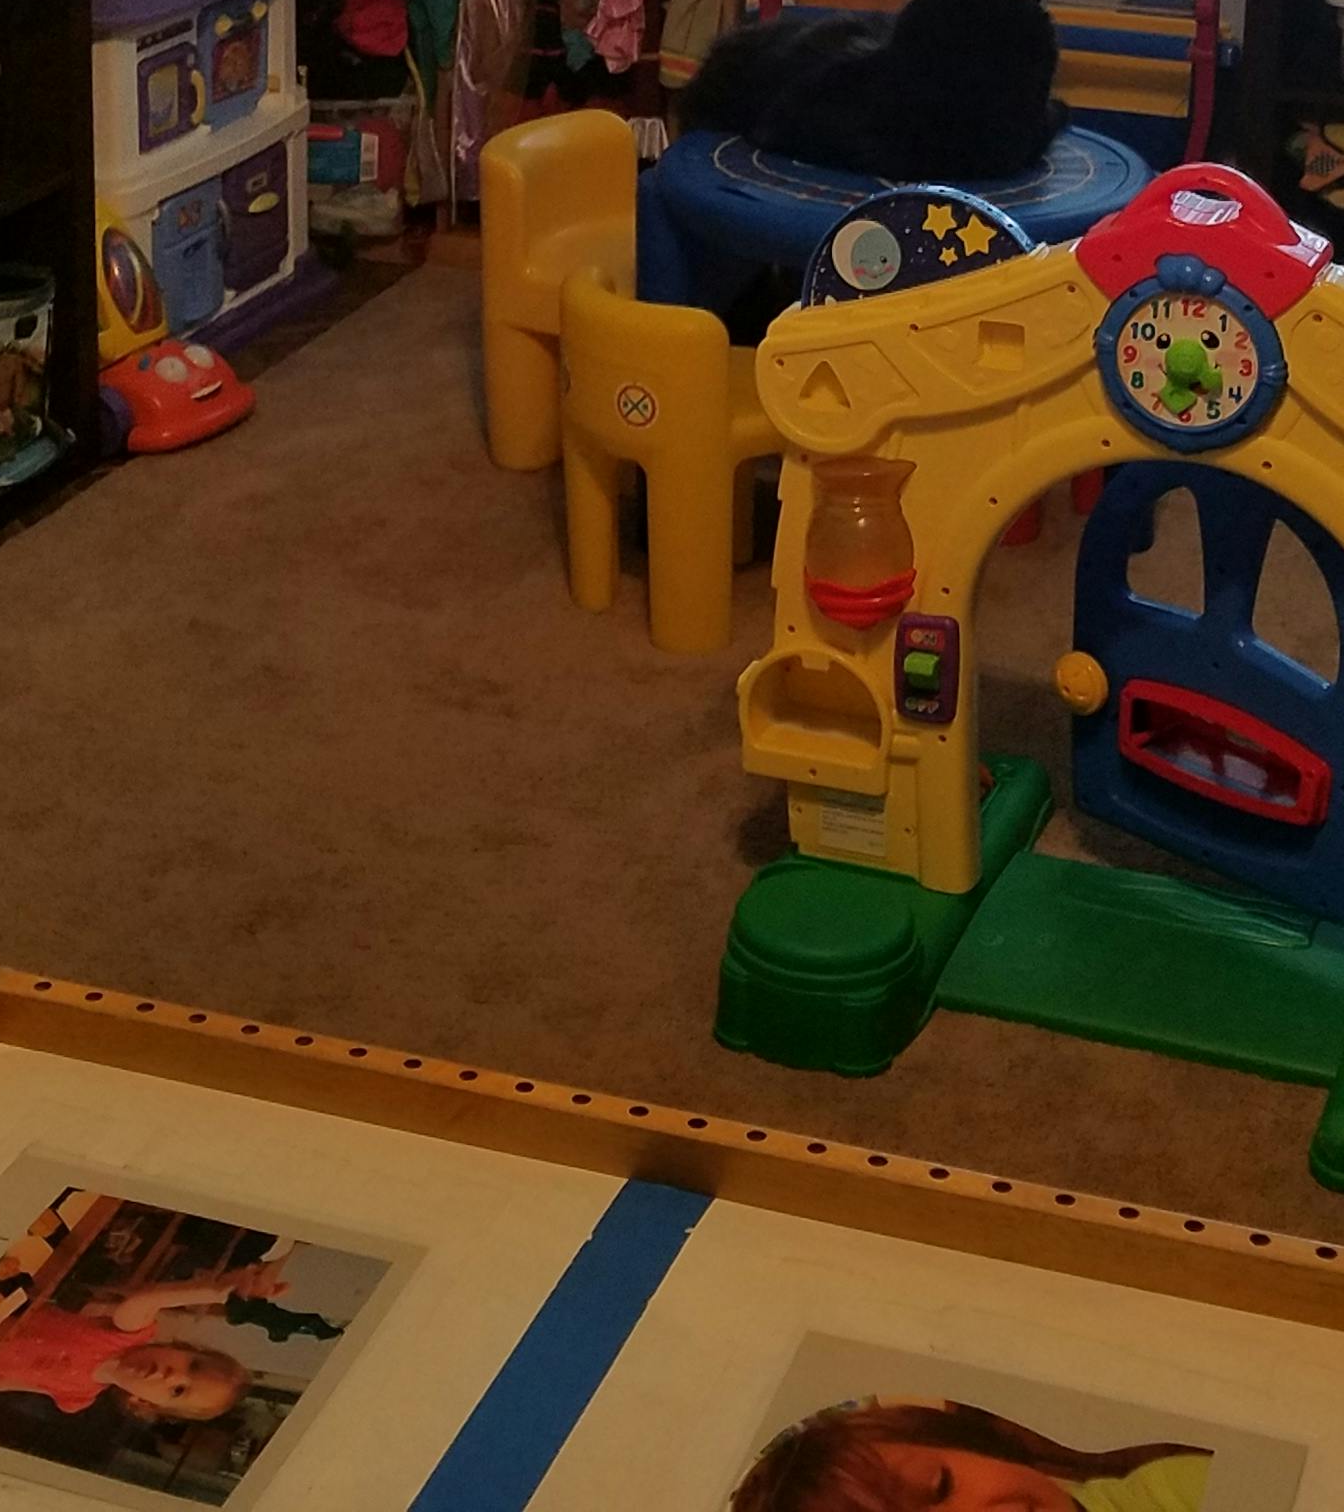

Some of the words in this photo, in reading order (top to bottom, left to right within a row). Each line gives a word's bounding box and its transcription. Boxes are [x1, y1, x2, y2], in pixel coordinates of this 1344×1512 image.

[1150, 300, 1171, 319] 11
[1180, 298, 1206, 319] 12
[1130, 321, 1156, 341] 10
[1219, 313, 1227, 332] 1
[1234, 330, 1250, 350] 2
[1122, 345, 1138, 364] 9
[1238, 358, 1253, 377] 3
[1130, 370, 1145, 390] 8
[1228, 385, 1243, 403] 4
[1206, 400, 1221, 420] 5
[910, 628, 937, 646] ON
[904, 696, 939, 714] OFF
